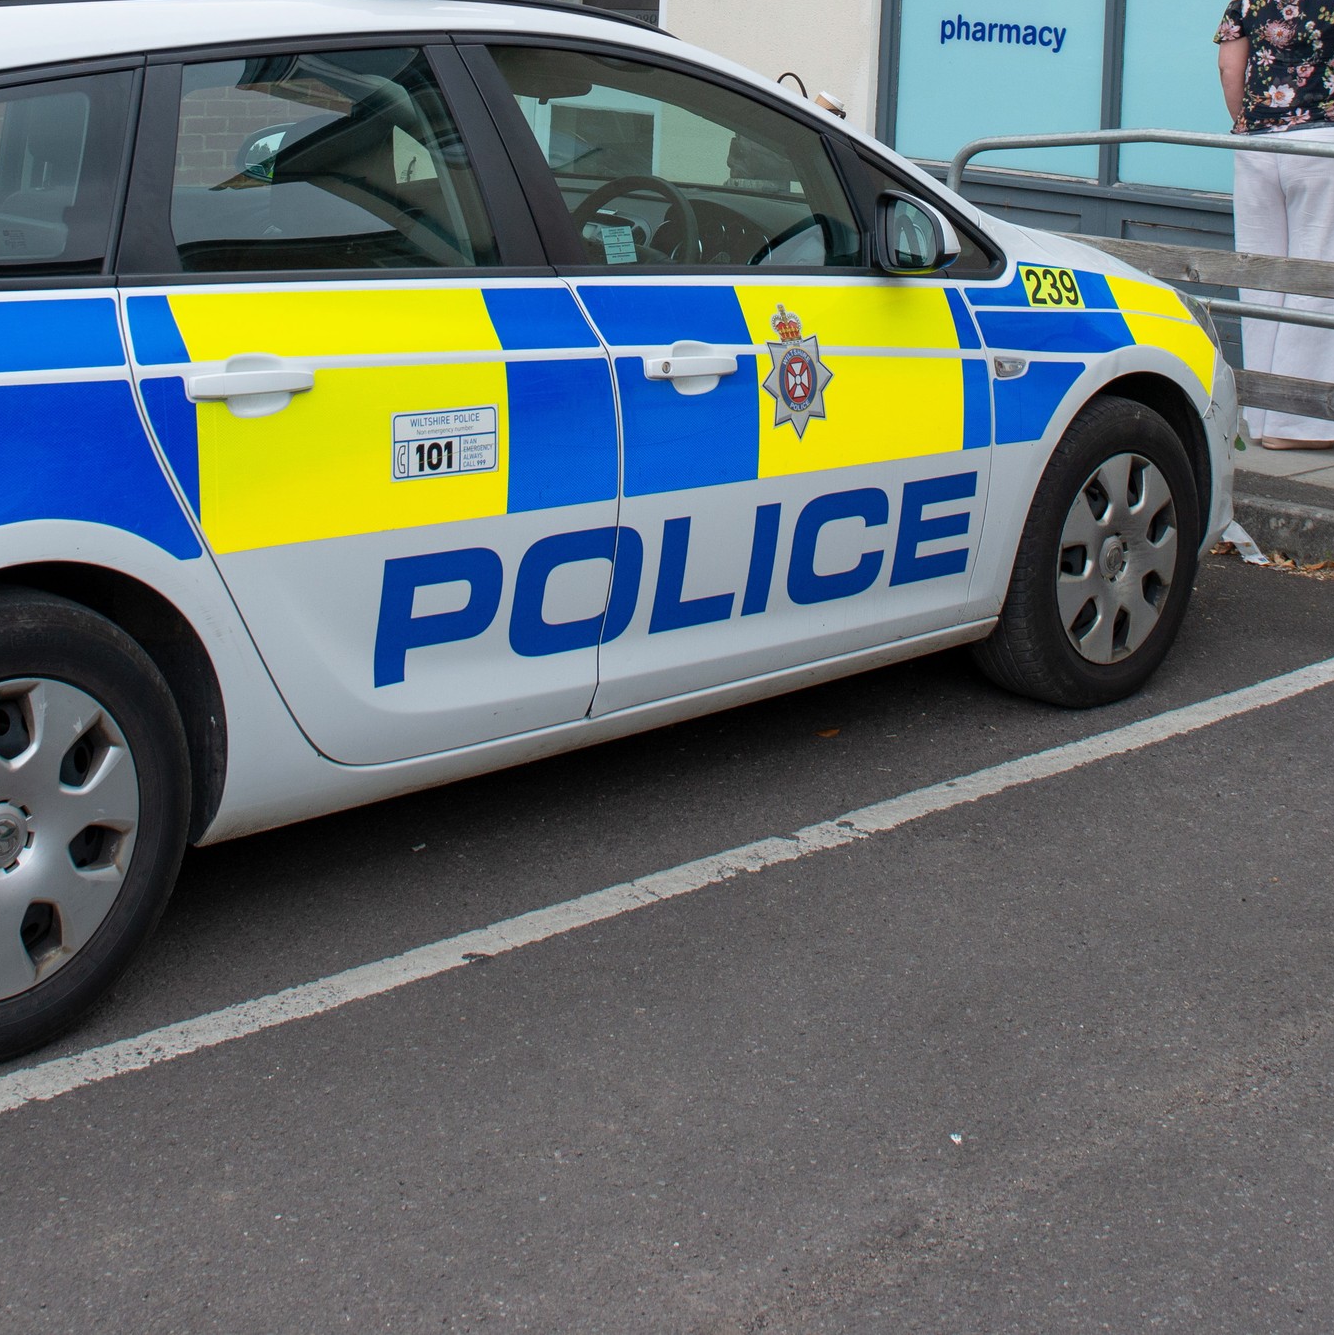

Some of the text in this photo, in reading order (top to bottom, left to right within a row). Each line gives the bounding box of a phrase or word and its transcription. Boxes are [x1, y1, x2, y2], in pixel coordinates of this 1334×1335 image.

[940, 13, 1066, 53] pharmacy
[1026, 269, 1079, 307] 239
[783, 348, 811, 365] WILTSHIRE
[789, 400, 810, 411] POLICE
[410, 413, 480, 427] WILTSHIRE POLICE
[427, 426, 454, 435] emergency
[454, 425, 474, 433] number
[416, 441, 453, 472] 101
[463, 444, 493, 452] EMERGENCY
[373, 470, 978, 688] POLICE
